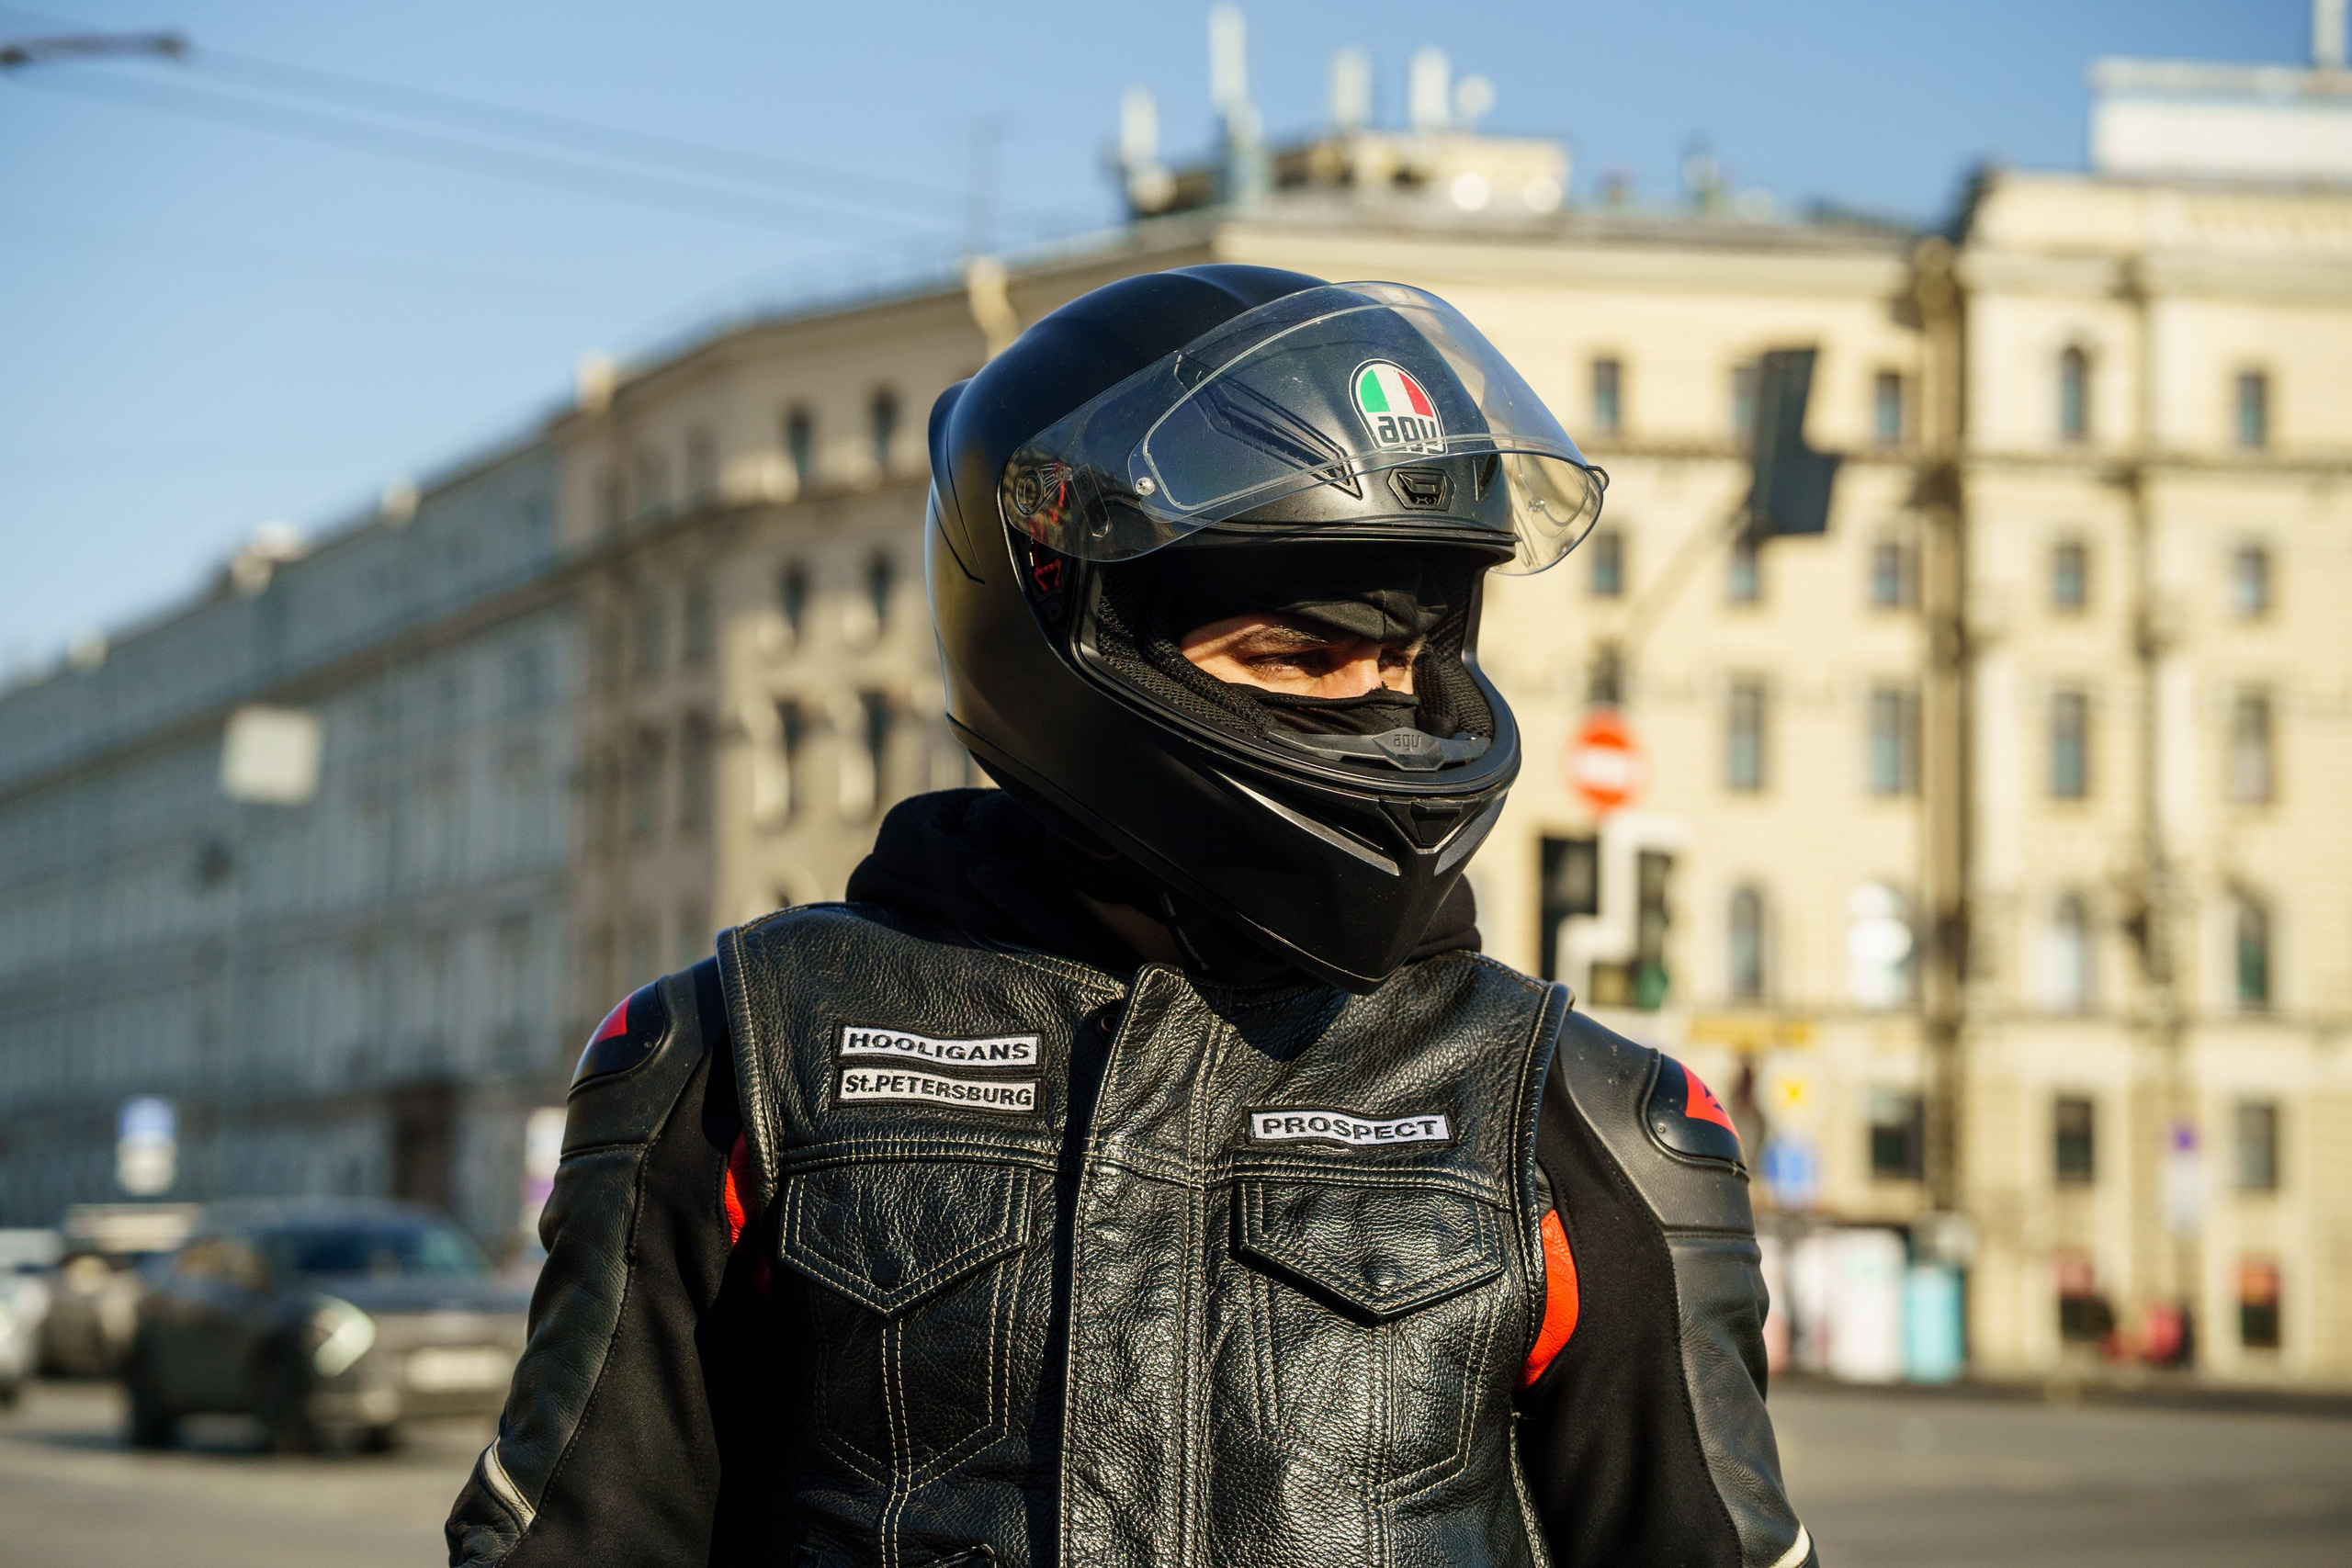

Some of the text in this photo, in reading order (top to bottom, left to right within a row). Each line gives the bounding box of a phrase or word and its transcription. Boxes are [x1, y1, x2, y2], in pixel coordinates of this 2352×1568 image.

[1394, 734, 1421, 751] agv
[847, 1032, 1030, 1060] HOOLIGANS
[845, 1075, 1032, 1105] St.PETERSBURG
[1262, 1116, 1437, 1139] PROSPECT
